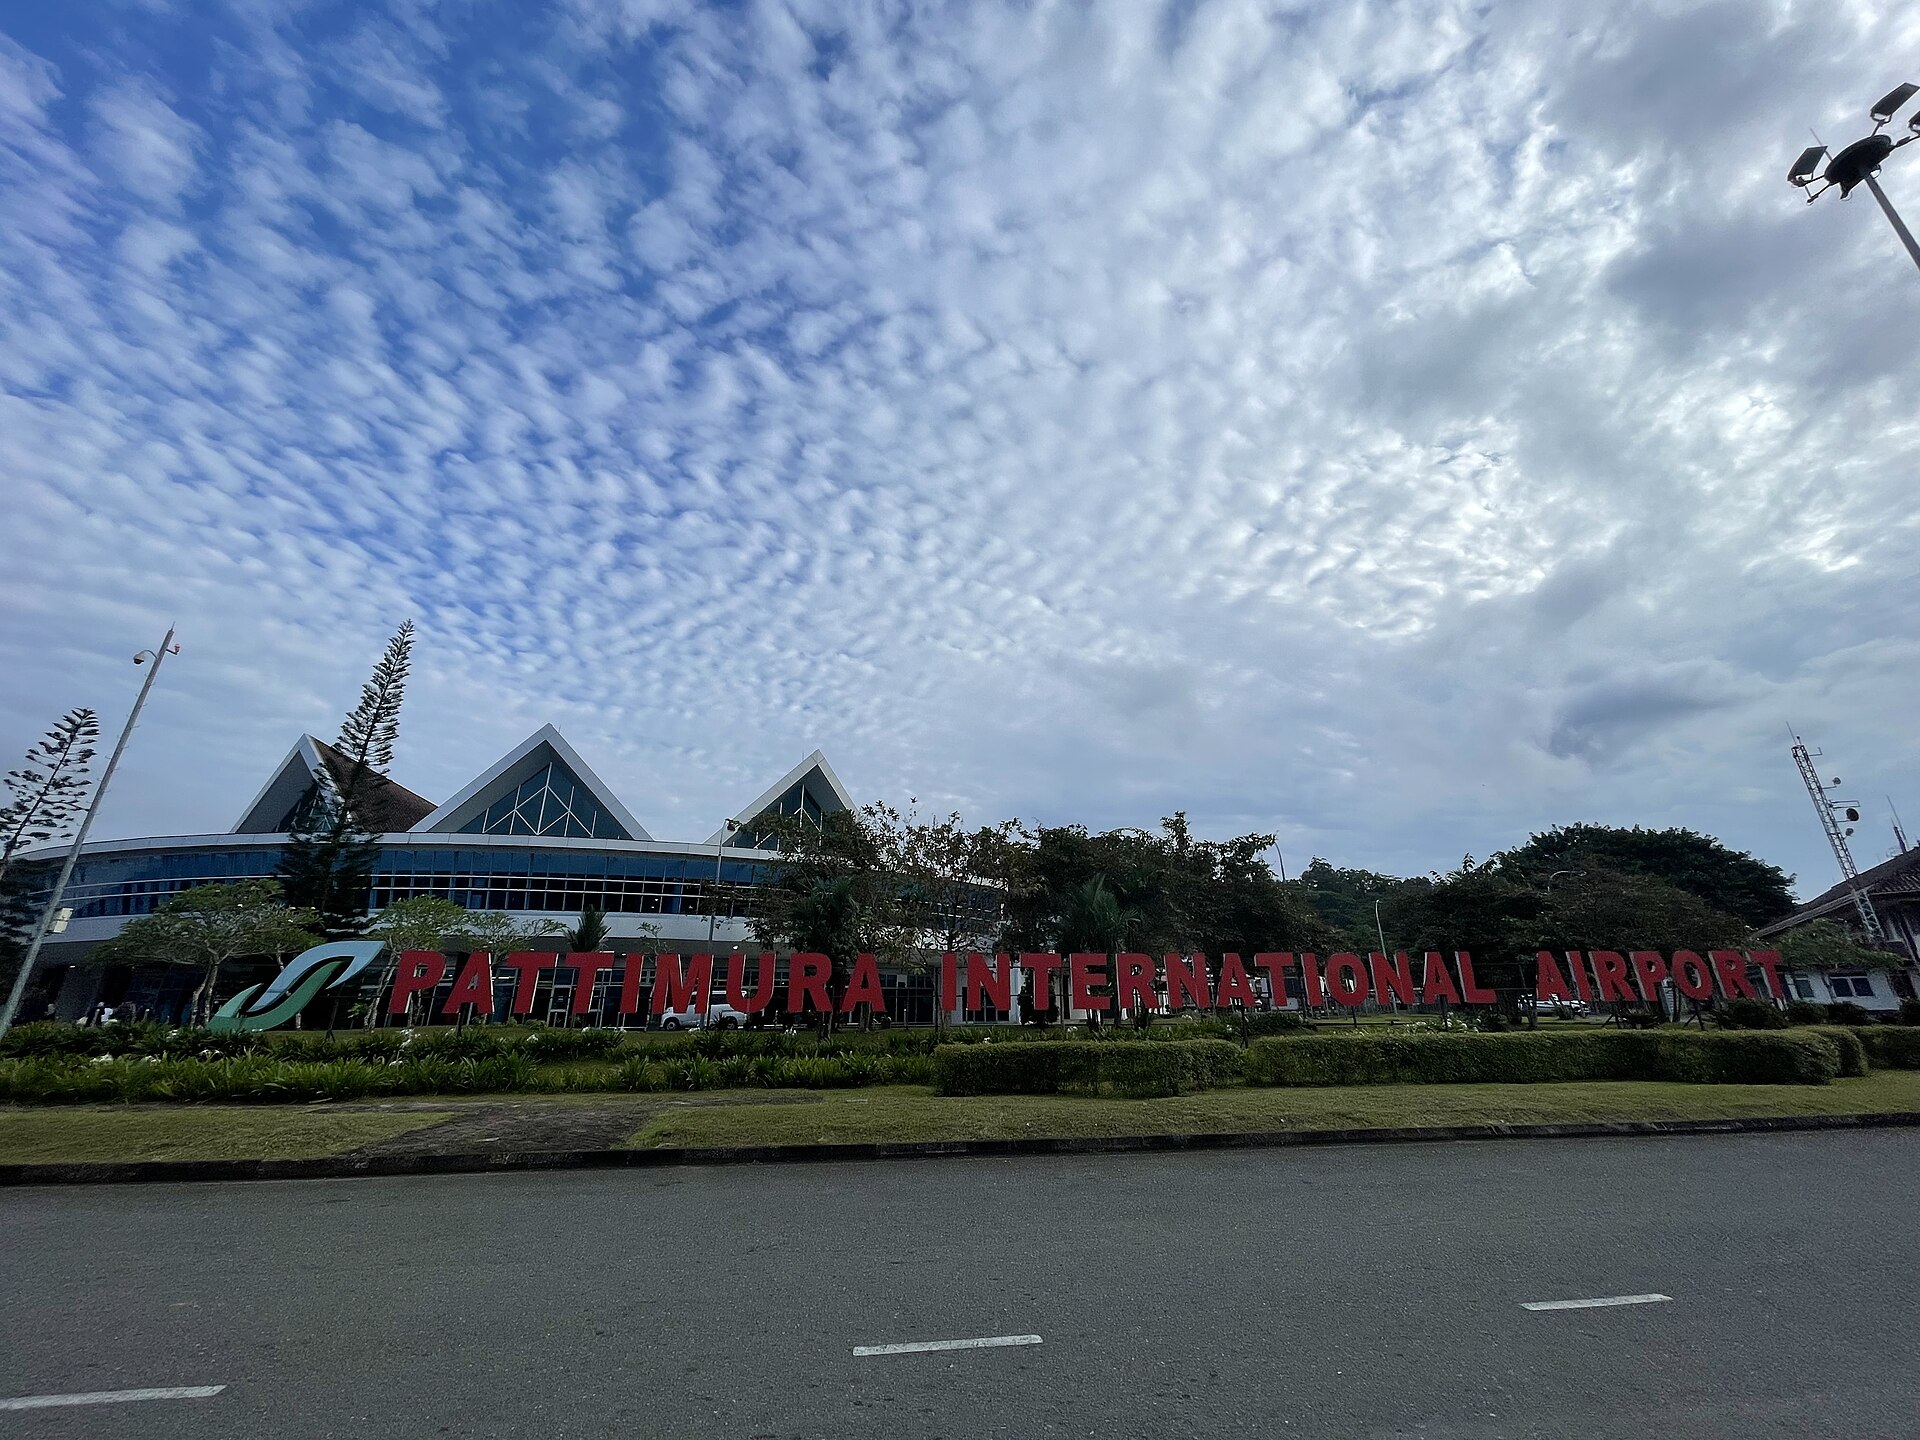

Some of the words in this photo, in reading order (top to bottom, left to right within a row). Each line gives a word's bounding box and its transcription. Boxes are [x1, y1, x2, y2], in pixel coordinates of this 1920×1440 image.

[388, 950, 885, 1014] PATTIMURA
[941, 952, 1496, 1011] INTERNATIONAL
[1536, 949, 1784, 1002] AIRPORT
